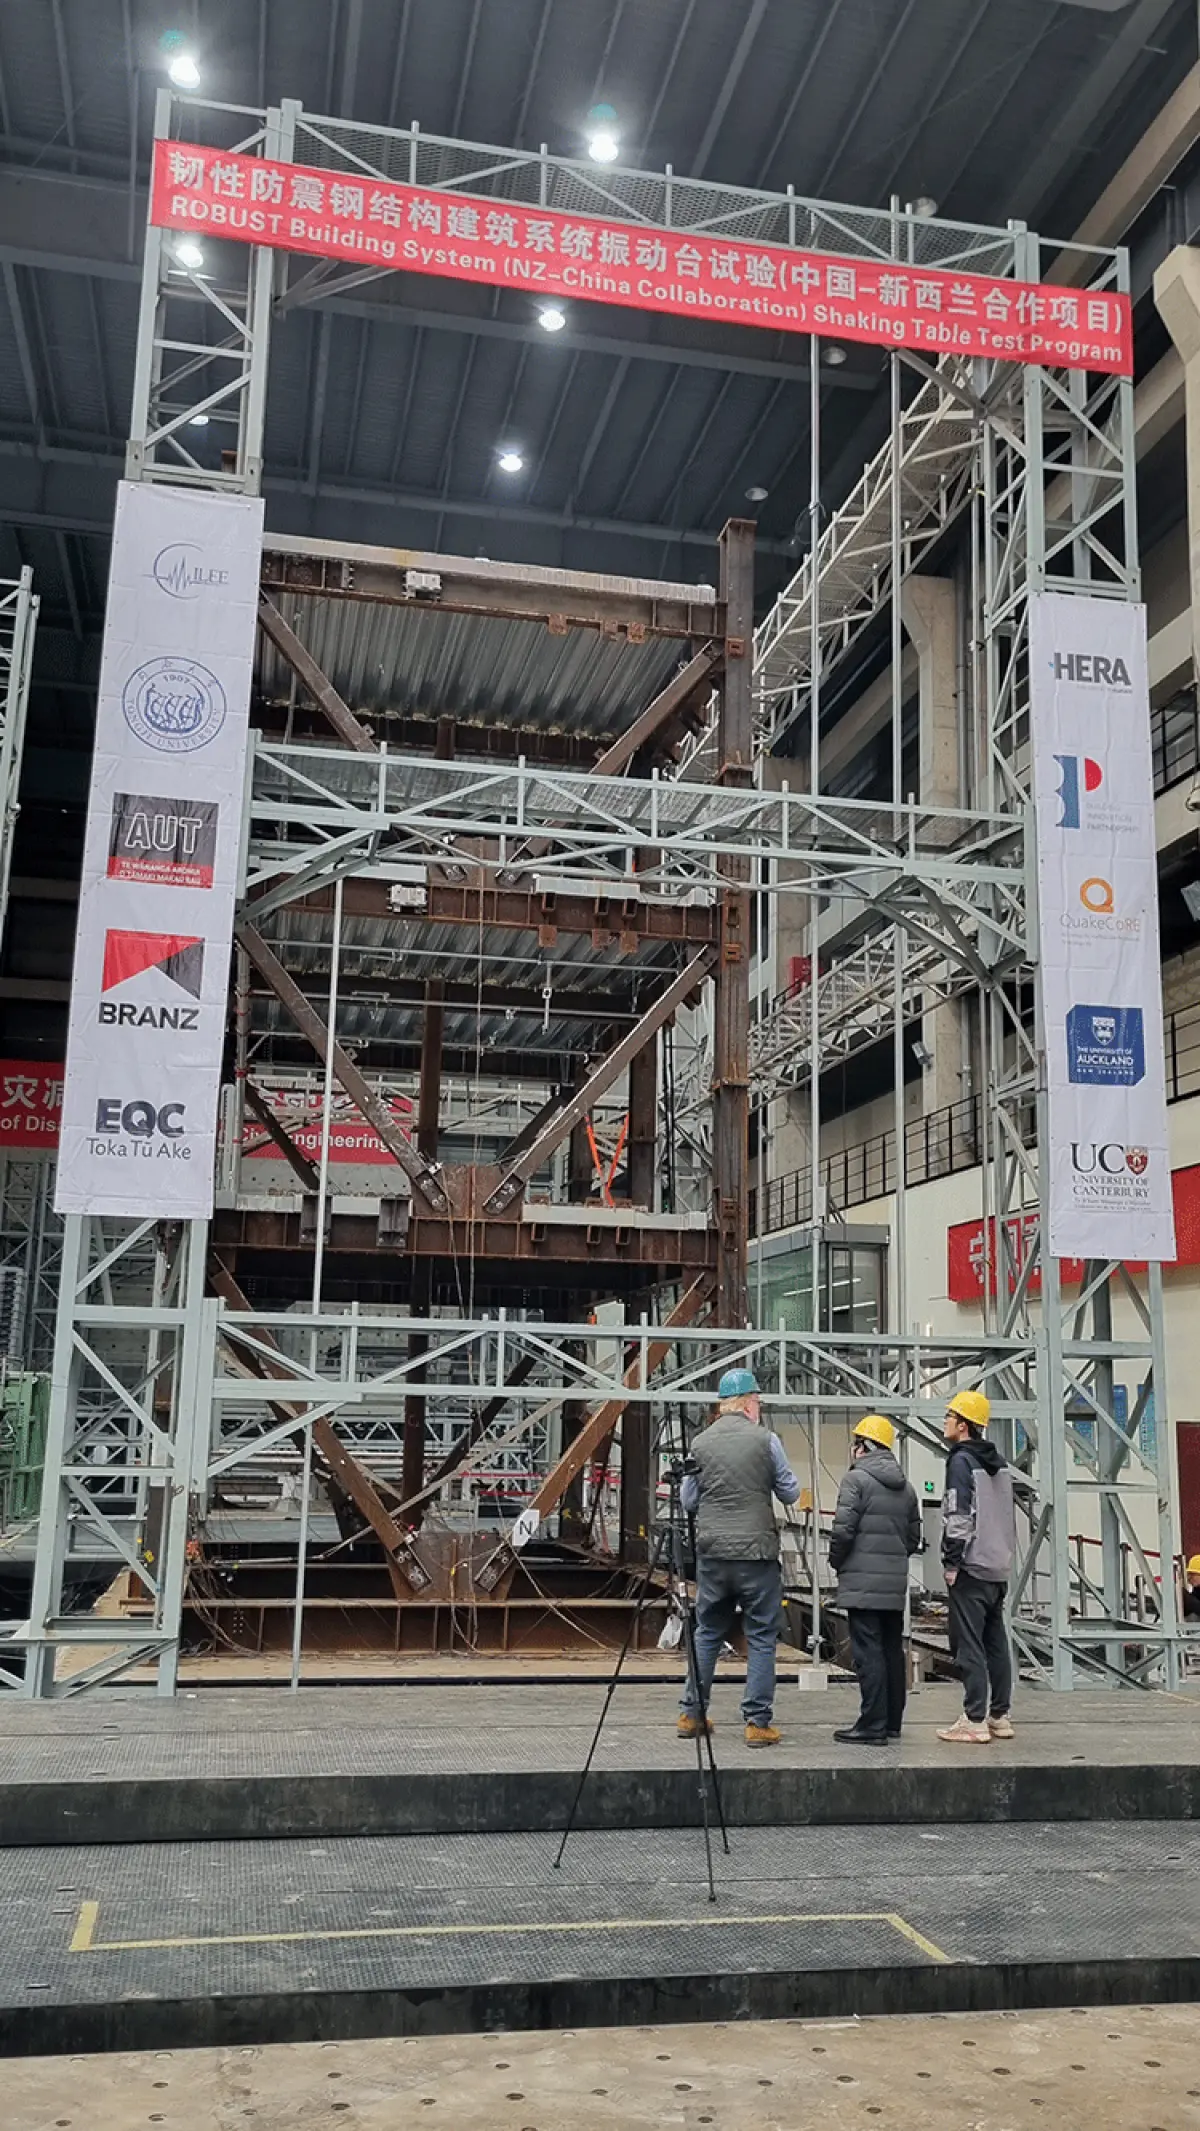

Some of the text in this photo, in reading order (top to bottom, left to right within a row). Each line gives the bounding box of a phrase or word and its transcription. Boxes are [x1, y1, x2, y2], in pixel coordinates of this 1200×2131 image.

[171, 196, 1122, 363] ROBUST Building System (NZ-China Collaboration) Shaking Table Test Program
[194, 567, 229, 585] ILEE
[163, 674, 190, 684] 1907
[1054, 652, 1131, 686] HERA
[125, 812, 202, 854] AUT
[1060, 913, 1140, 932] QuakeCoRE
[98, 1002, 200, 1031] BRANZ
[1077, 1054, 1133, 1066] AUCKLAND
[1, 1114, 61, 1132] of Dis
[96, 1098, 186, 1138] EQC
[86, 1137, 191, 1160] Toka Tū Ake
[288, 1130, 390, 1152] ngineering
[1070, 1142, 1125, 1174] UC
[1072, 1175, 1149, 1186] UNIVERSITY OF
[1072, 1186, 1150, 1198] CANTERBURY
